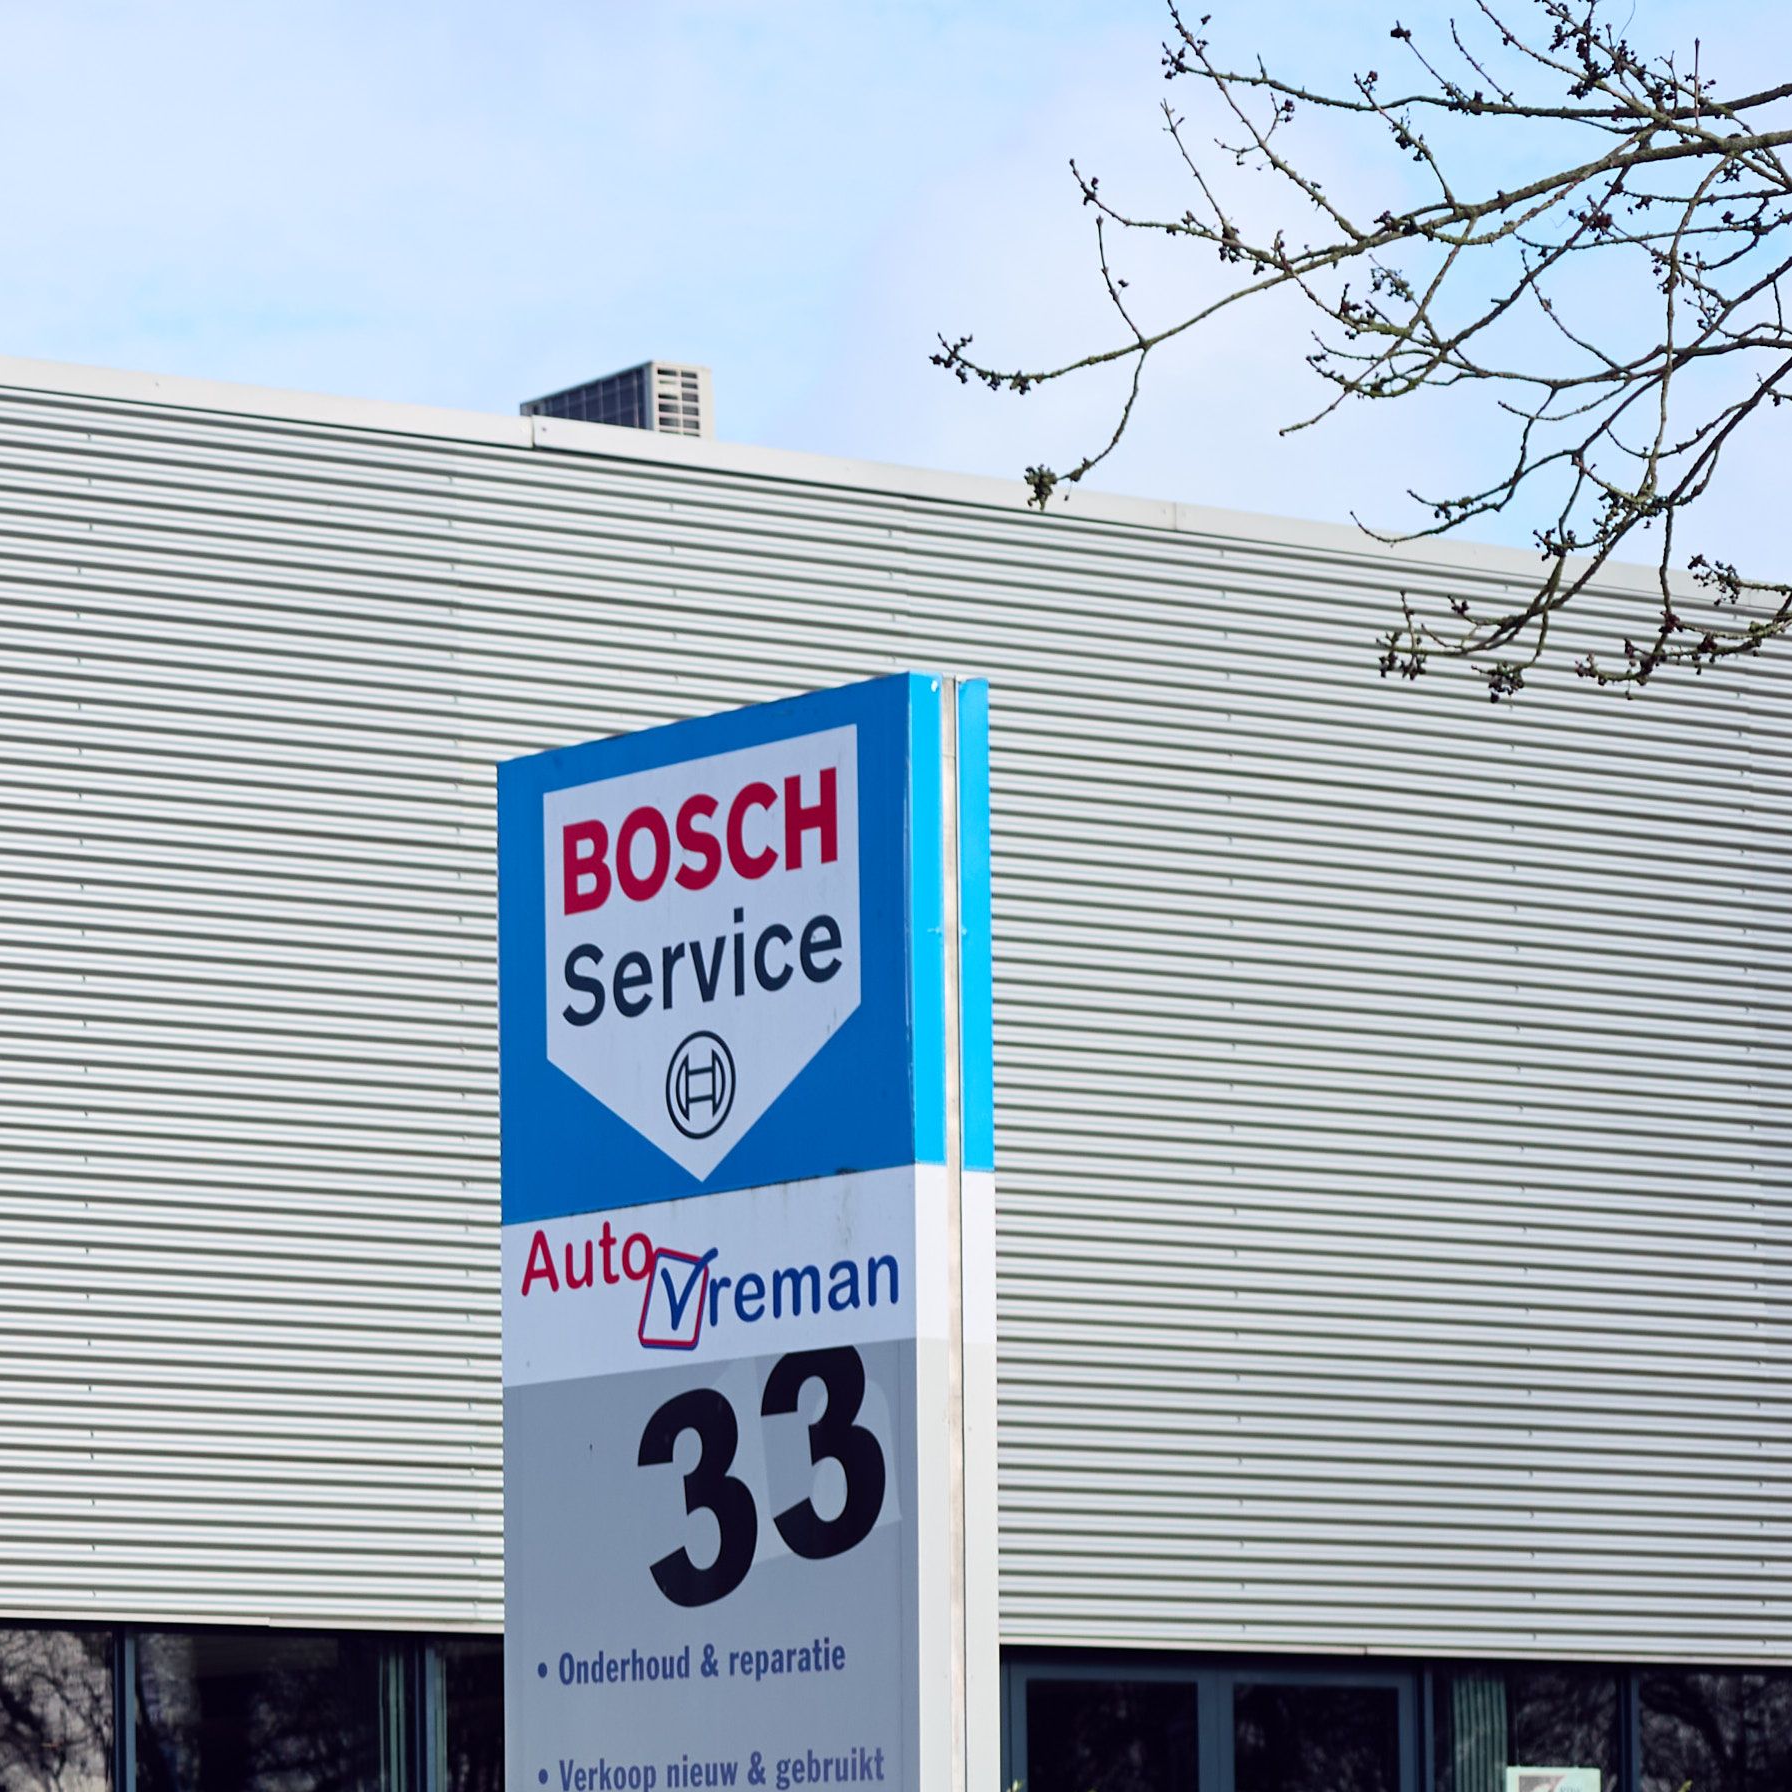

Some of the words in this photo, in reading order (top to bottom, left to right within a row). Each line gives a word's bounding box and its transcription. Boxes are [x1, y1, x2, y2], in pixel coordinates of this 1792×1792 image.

[563, 767, 838, 916] BOSCH
[562, 907, 843, 1027] Service
[521, 1221, 654, 1296] Auto
[661, 1247, 899, 1331] Vreman
[637, 1345, 886, 1608] 33
[558, 1645, 690, 1685] Onderhoud
[700, 1643, 719, 1678] &
[728, 1637, 846, 1682] reparatie
[667, 1755, 739, 1788] nieuw
[747, 1751, 766, 1786] &
[776, 1747, 885, 1791] gebruikt
